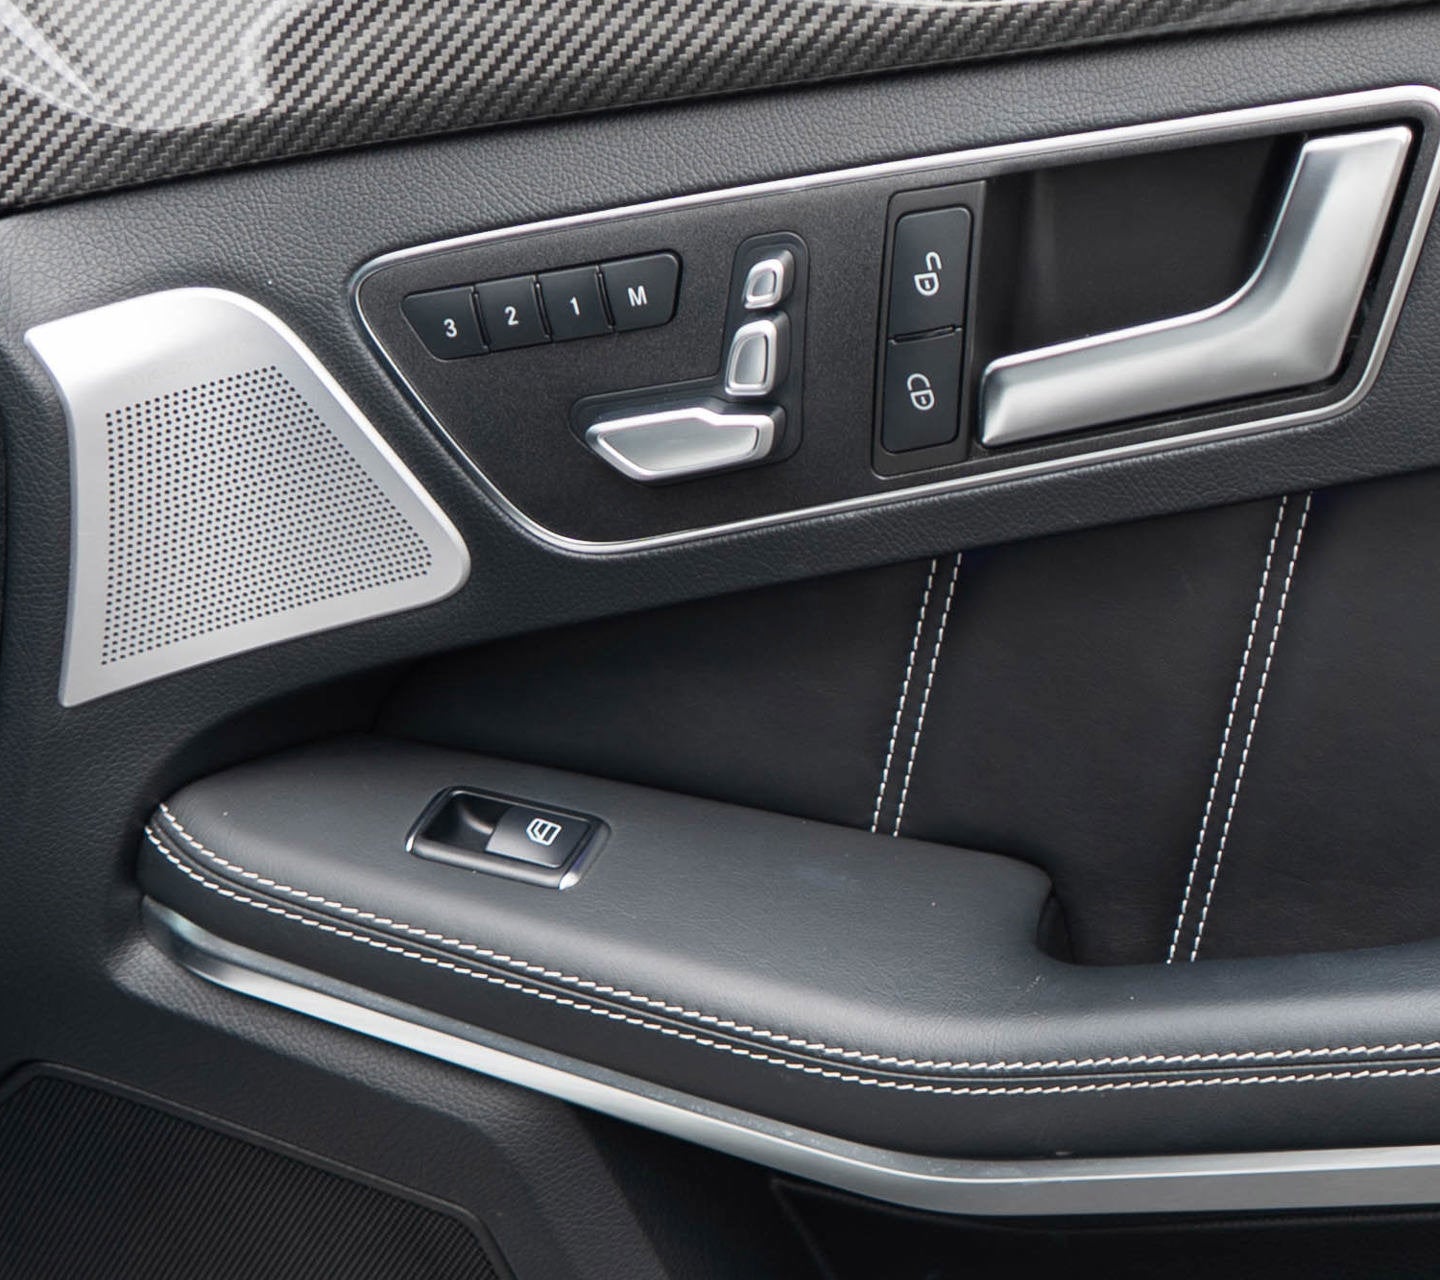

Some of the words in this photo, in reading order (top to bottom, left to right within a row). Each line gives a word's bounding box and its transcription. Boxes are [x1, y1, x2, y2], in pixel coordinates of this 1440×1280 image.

[444, 318, 458, 338] 3
[504, 306, 519, 326] 2
[570, 296, 581, 316] 1
[627, 285, 648, 307] M
